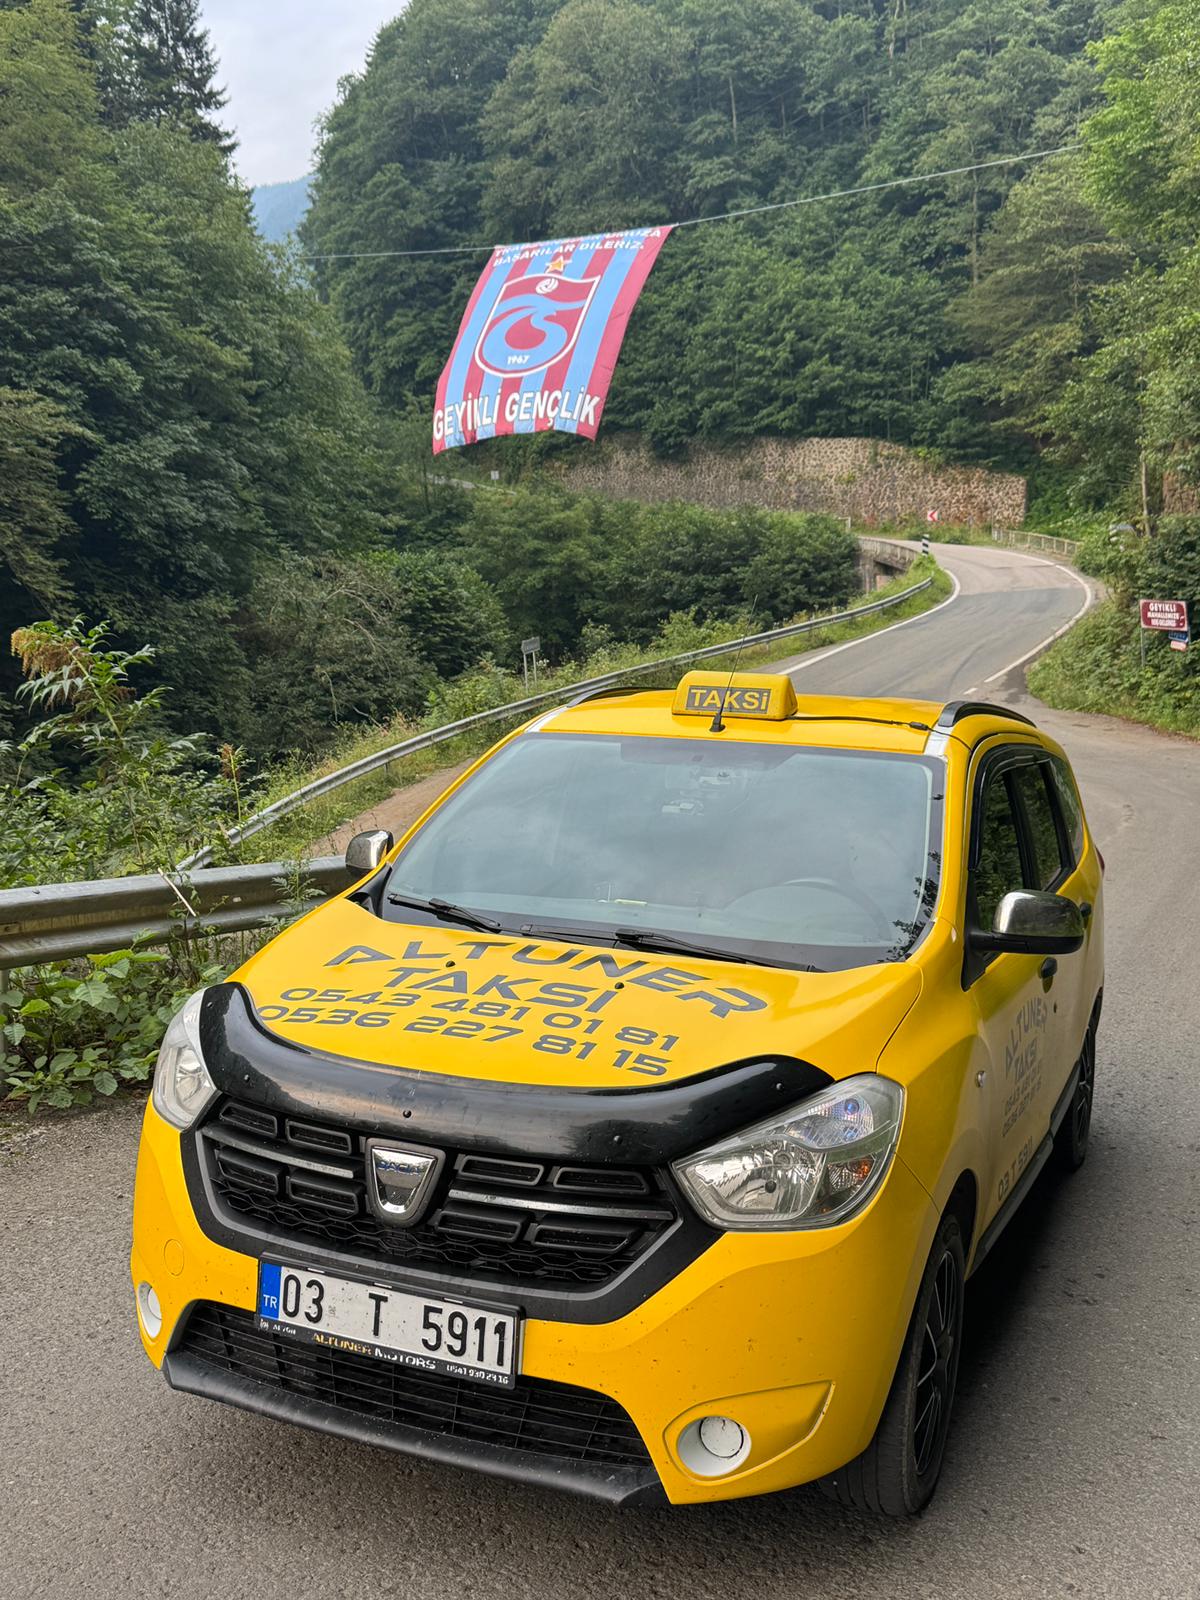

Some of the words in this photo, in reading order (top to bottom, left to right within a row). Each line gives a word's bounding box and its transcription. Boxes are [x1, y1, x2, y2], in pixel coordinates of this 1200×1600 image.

[507, 355, 530, 365] 1967
[433, 388, 502, 441] GEYİKLİ
[505, 387, 600, 427] GENÇLİK
[324, 941, 768, 1019] ALTUNER
[257, 1005, 396, 1028] 0536
[403, 1015, 524, 1042] 227
[532, 1034, 597, 1060] 81
[612, 1049, 672, 1076] 15
[280, 987, 422, 1007] 0543
[431, 998, 531, 1021] 481
[543, 1012, 604, 1035] 01
[615, 1026, 680, 1051] 81
[263, 1294, 278, 1310] TR
[282, 1274, 325, 1324] 03
[368, 1291, 389, 1337] T
[421, 1304, 507, 1367] 5911
[374, 1347, 436, 1370] MOTORS
